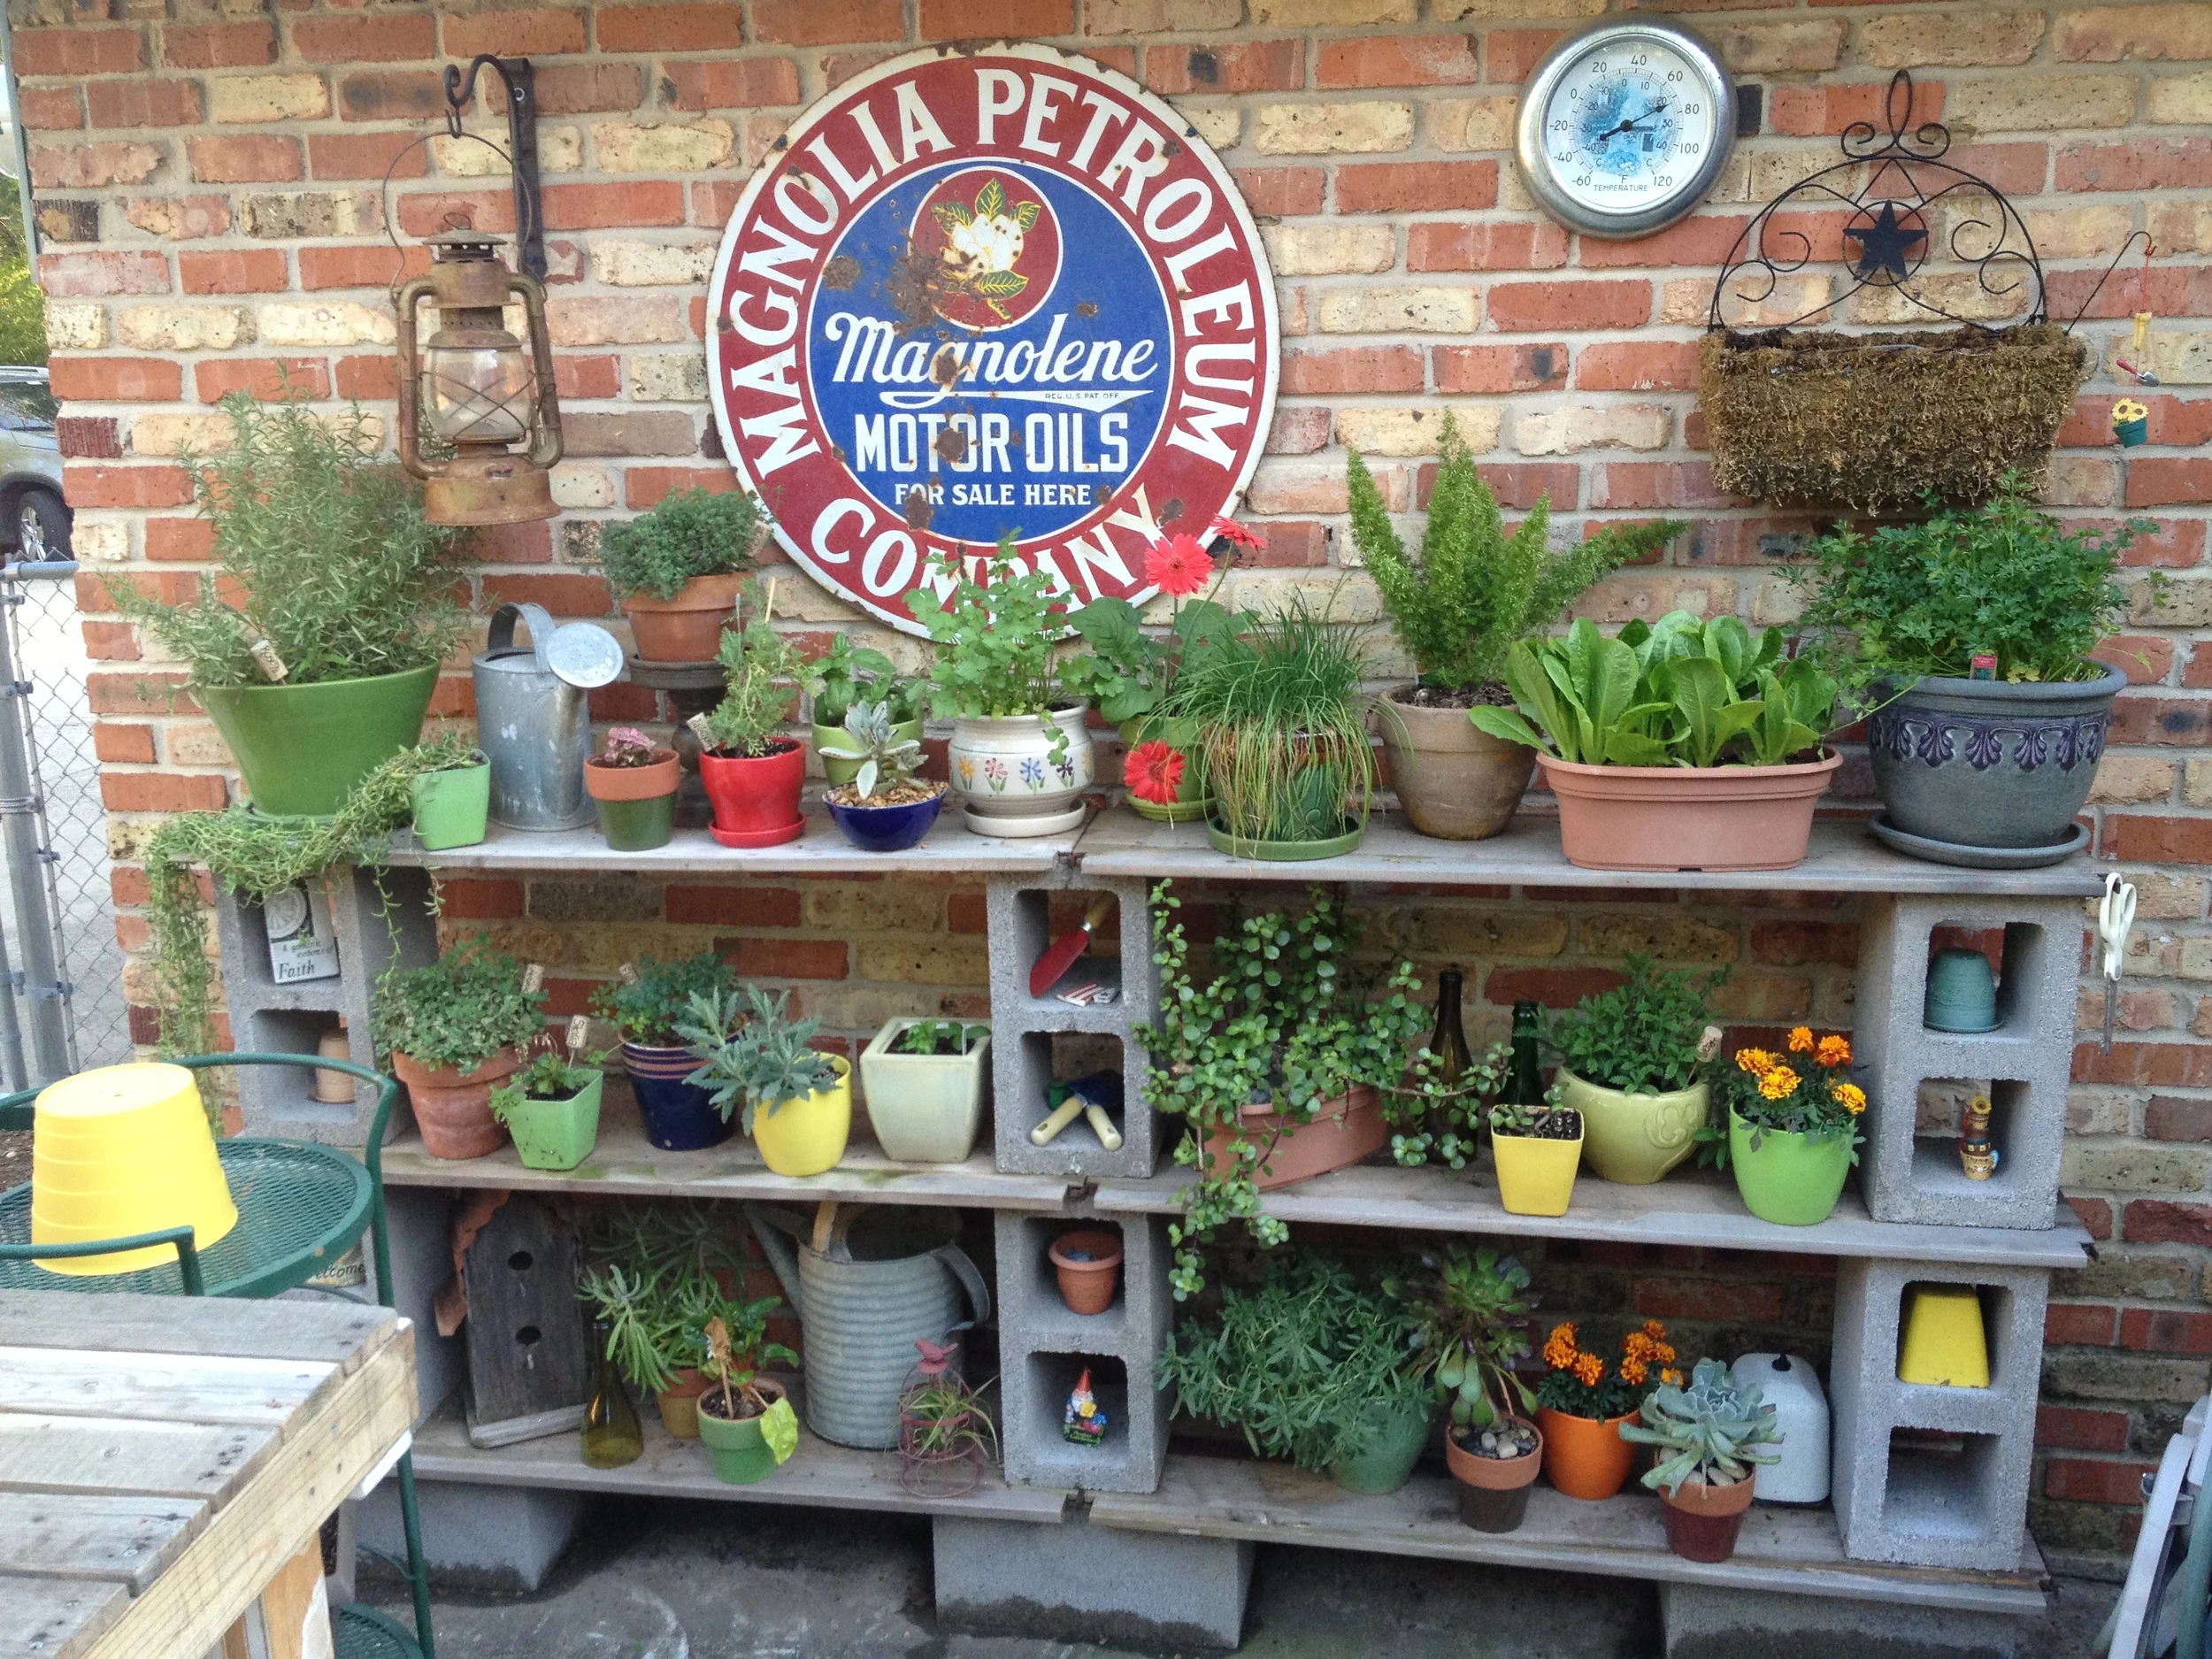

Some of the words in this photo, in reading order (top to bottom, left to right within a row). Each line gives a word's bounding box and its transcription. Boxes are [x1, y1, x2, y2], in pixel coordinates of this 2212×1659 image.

[1632, 55, 1647, 65] 40
[1593, 62, 1607, 73] 20
[1668, 71, 1683, 82] 60
[1640, 81, 1650, 90] 10
[1571, 88, 1578, 99] 0
[1685, 104, 1700, 115] 80
[1549, 120, 1568, 131] -20
[1680, 143, 1700, 154] 100
[1553, 151, 1572, 162] -40
[1571, 176, 1591, 187] -60
[1654, 176, 1672, 187] 120
[728, 80, 956, 478] MAGNOLIA
[973, 68, 1256, 471] PETROLEUM
[825, 312, 1158, 410] Magnolene
[855, 413, 1011, 472] MOTOR
[1025, 412, 1128, 472] OILS
[952, 483, 1016, 505] SALE
[1025, 483, 1091, 505] HERE
[279, 959, 315, 979] Faith
